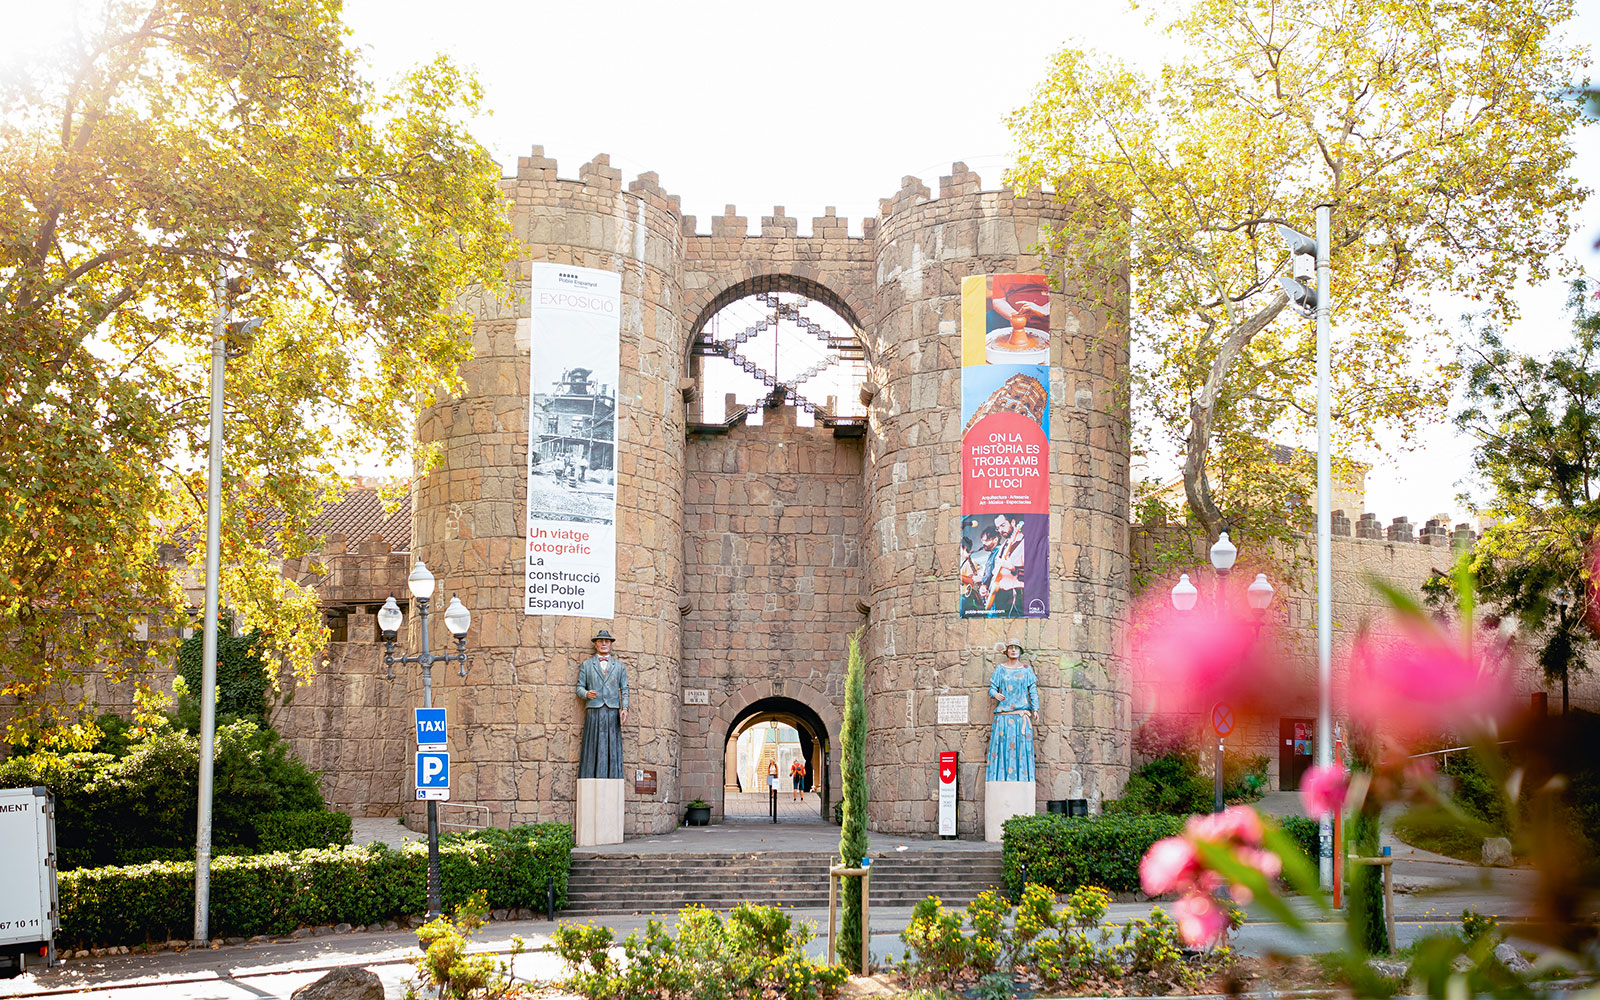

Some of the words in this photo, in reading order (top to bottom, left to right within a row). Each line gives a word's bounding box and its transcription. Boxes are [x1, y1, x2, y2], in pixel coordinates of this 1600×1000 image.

[540, 292, 614, 312] EXPOSICIÓ
[989, 433, 1006, 442] ON
[1009, 433, 1023, 442] LA
[971, 443, 1024, 455] HISTÒRIA
[1026, 444, 1040, 454] ES
[973, 456, 1011, 466] TROBA
[1013, 456, 1038, 466] AMB
[972, 469, 986, 478] LA
[987, 467, 1040, 477] CULTURA
[989, 479, 992, 489] I
[994, 479, 1022, 488] L'OCI
[530, 528, 547, 538] Un
[550, 528, 589, 542] viatge
[530, 542, 590, 555] fotogràfic
[530, 556, 544, 566] La
[528, 571, 600, 583] construcció
[528, 584, 548, 594] del
[551, 584, 585, 596] Poble
[528, 597, 584, 611] Espanyol
[418, 721, 444, 732] TAXI
[423, 756, 442, 784] P
[0, 803, 29, 813] MENT
[0, 921, 11, 930] 67
[15, 919, 26, 928] 10
[29, 918, 39, 927] 11
